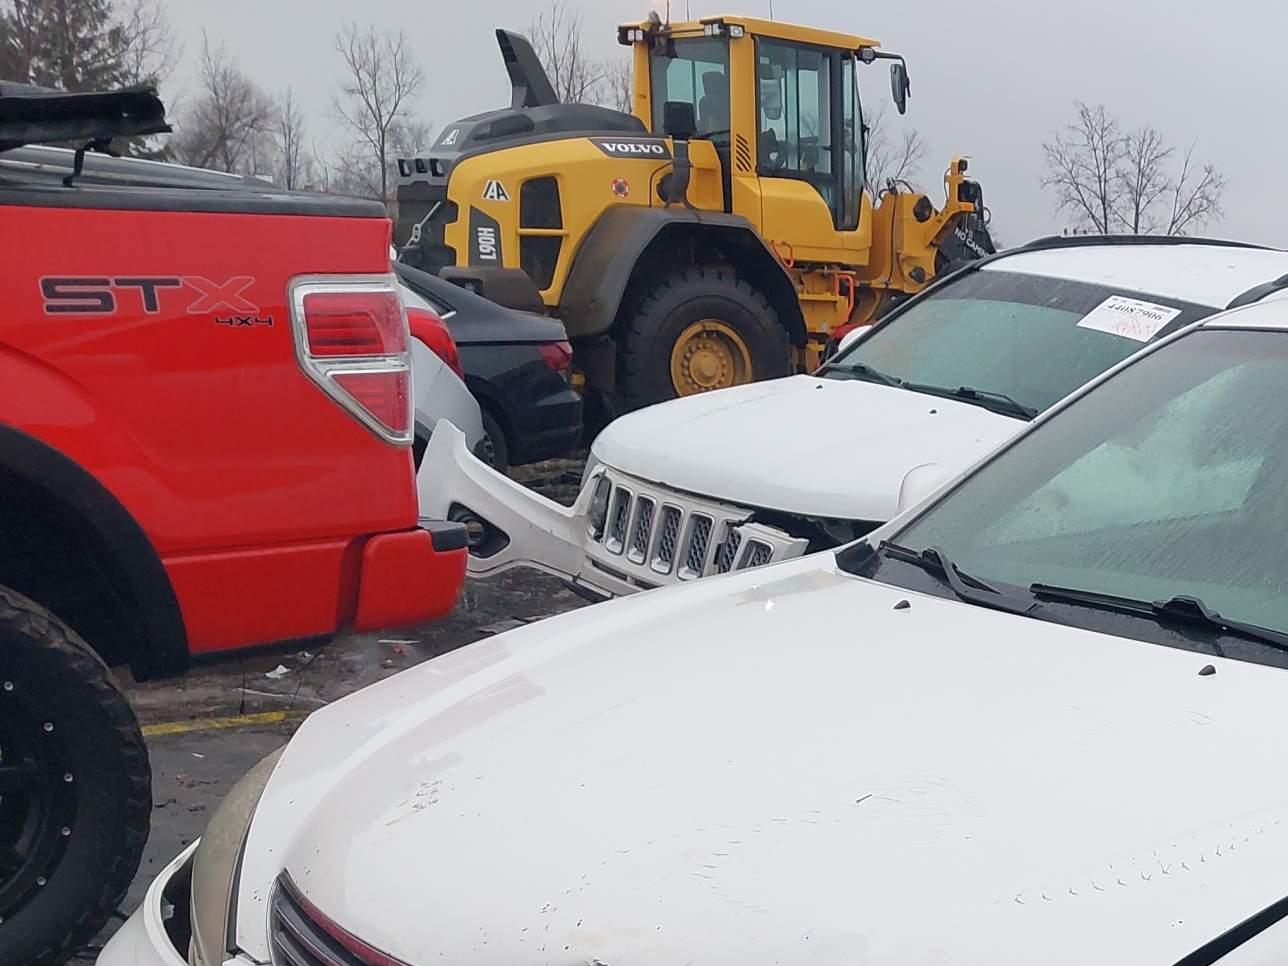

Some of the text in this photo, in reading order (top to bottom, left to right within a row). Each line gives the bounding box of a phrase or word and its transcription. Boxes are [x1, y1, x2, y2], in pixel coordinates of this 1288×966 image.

[601, 142, 664, 154] VOLVO
[477, 227, 497, 260] L90H
[954, 227, 990, 258] NO CAMIN
[39, 275, 260, 315] STX
